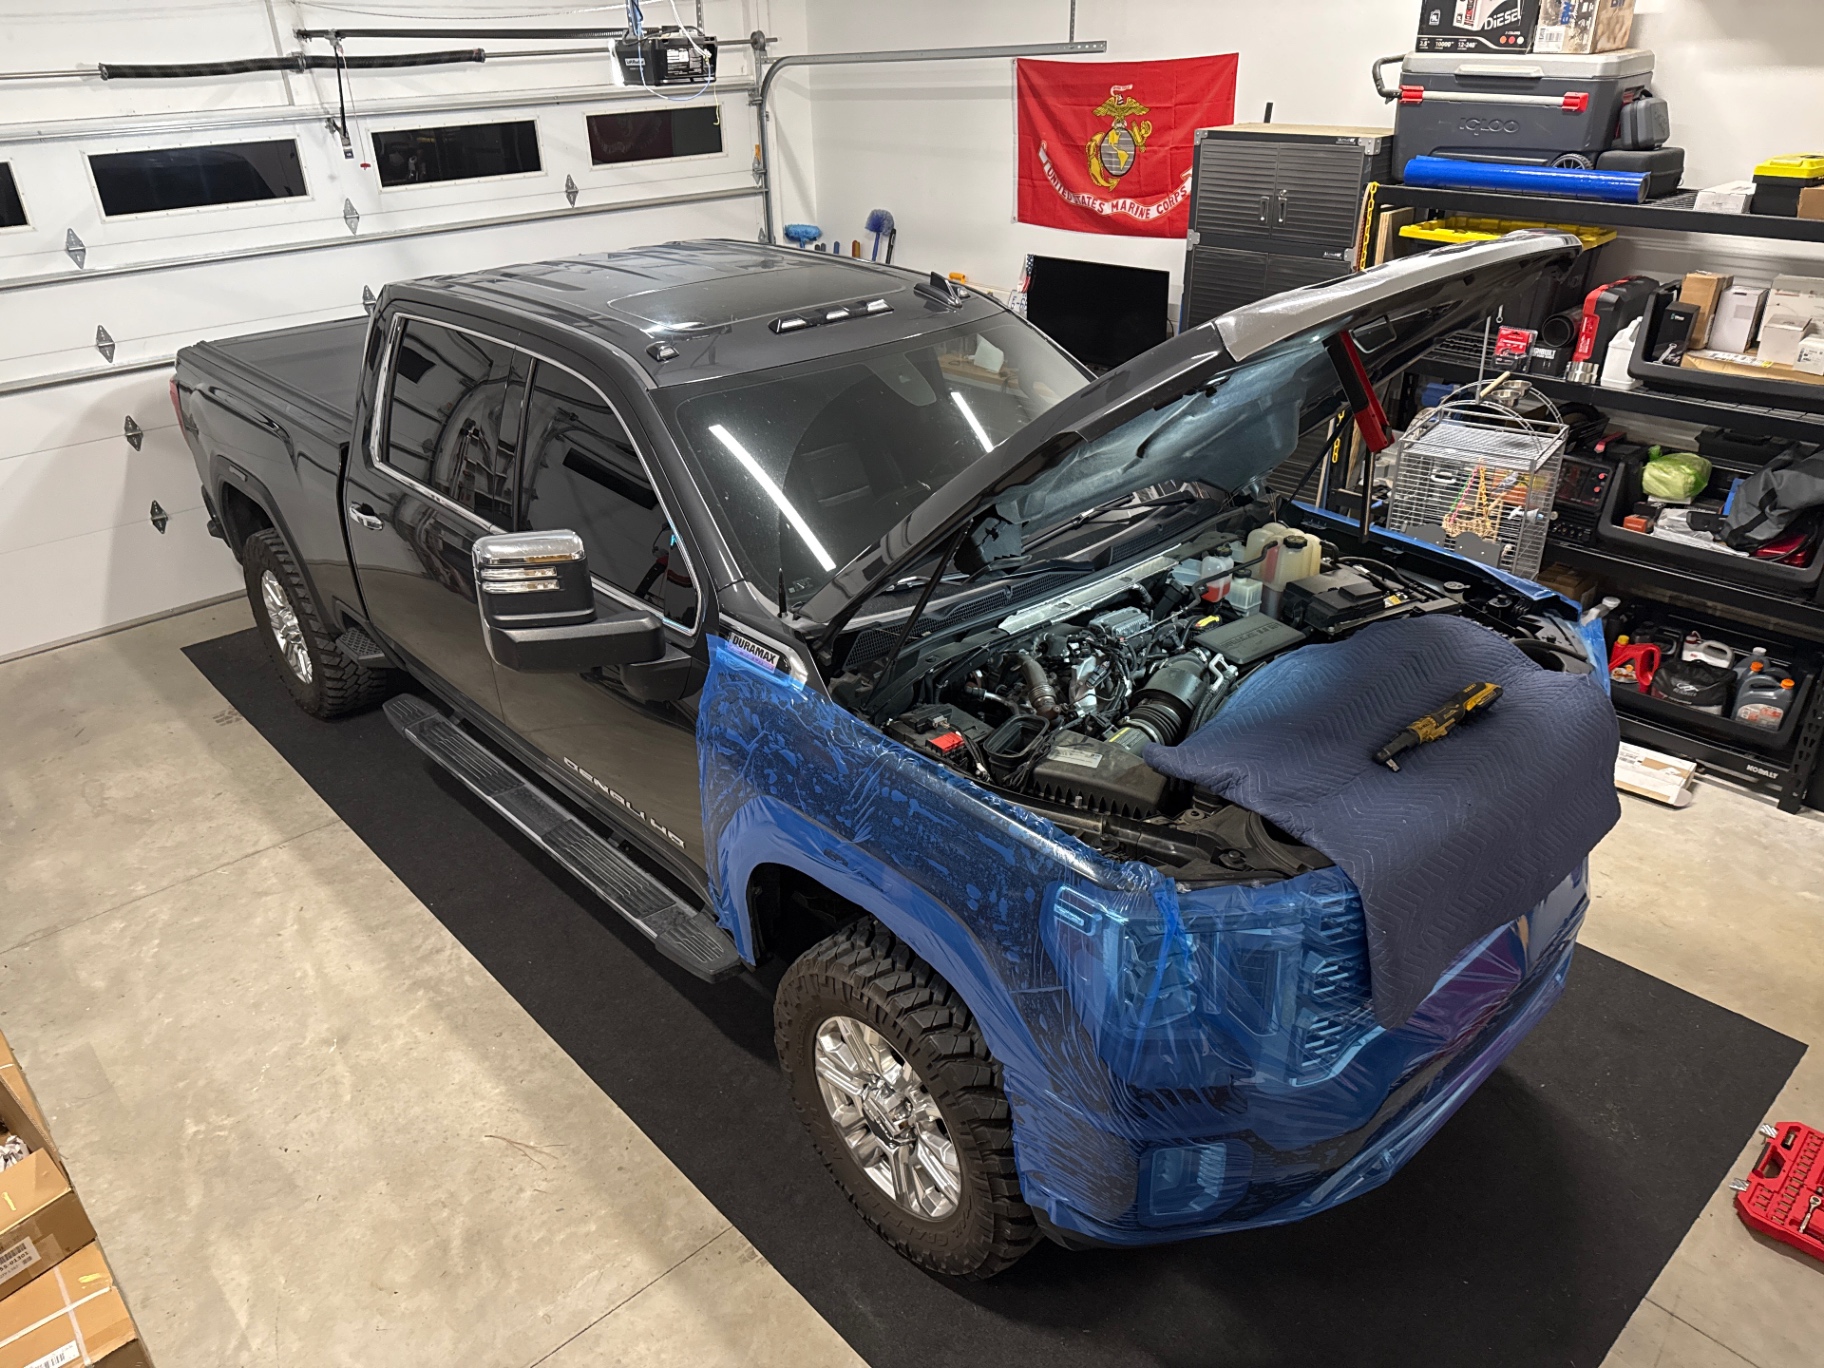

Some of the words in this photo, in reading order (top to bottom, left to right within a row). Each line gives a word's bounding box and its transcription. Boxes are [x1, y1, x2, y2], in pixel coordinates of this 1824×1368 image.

[1047, 167, 1073, 201] UNITED
[1074, 195, 1105, 214] TATES
[1111, 200, 1151, 219] MARINE
[1156, 185, 1188, 215] CORPS
[732, 635, 777, 664] DURAMAX
